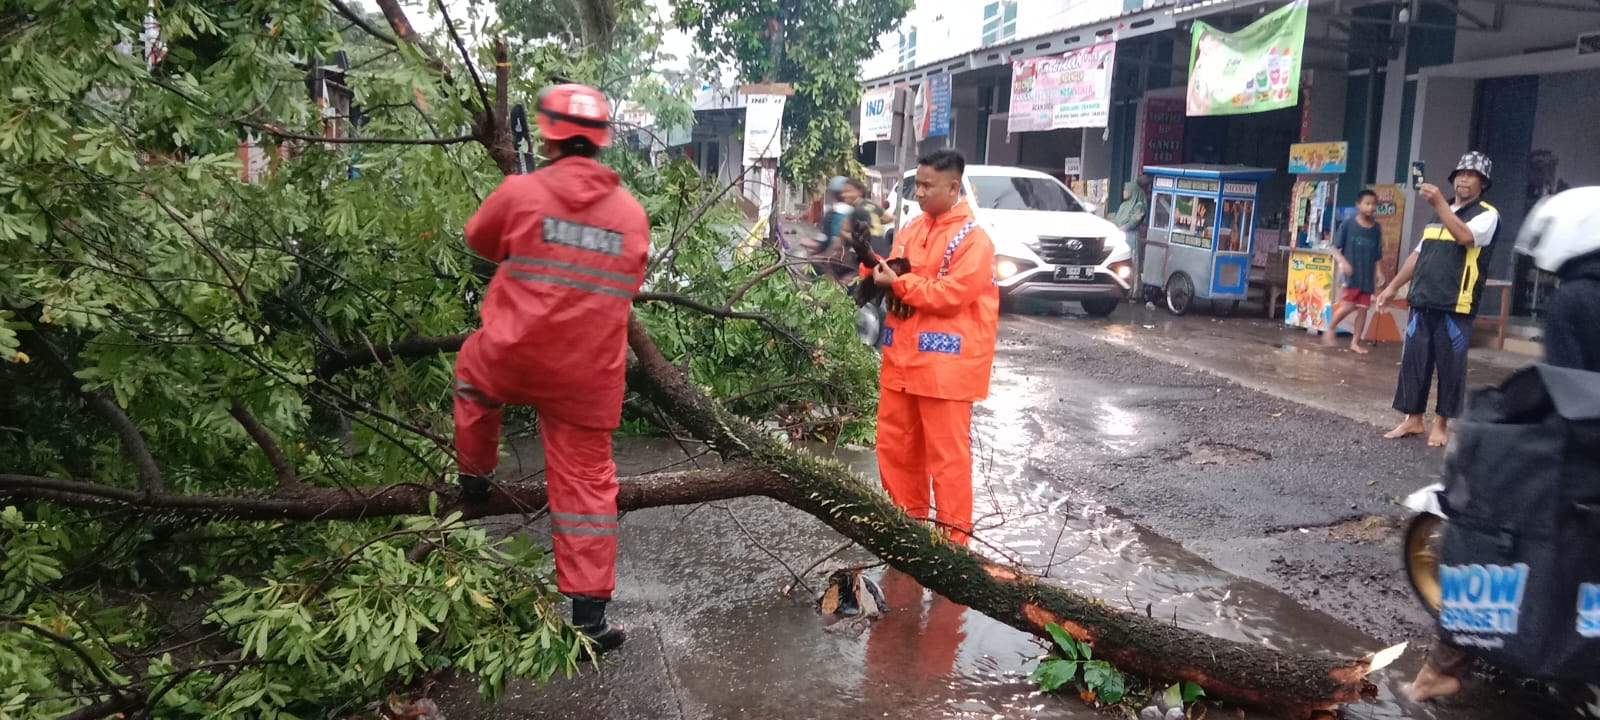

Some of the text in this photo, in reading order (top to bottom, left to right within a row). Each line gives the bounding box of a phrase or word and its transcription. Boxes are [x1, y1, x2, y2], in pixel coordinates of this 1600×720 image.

[1148, 139, 1181, 150] GANTI
[1153, 152, 1173, 161] LCD
[1440, 563, 1529, 604] WOW
